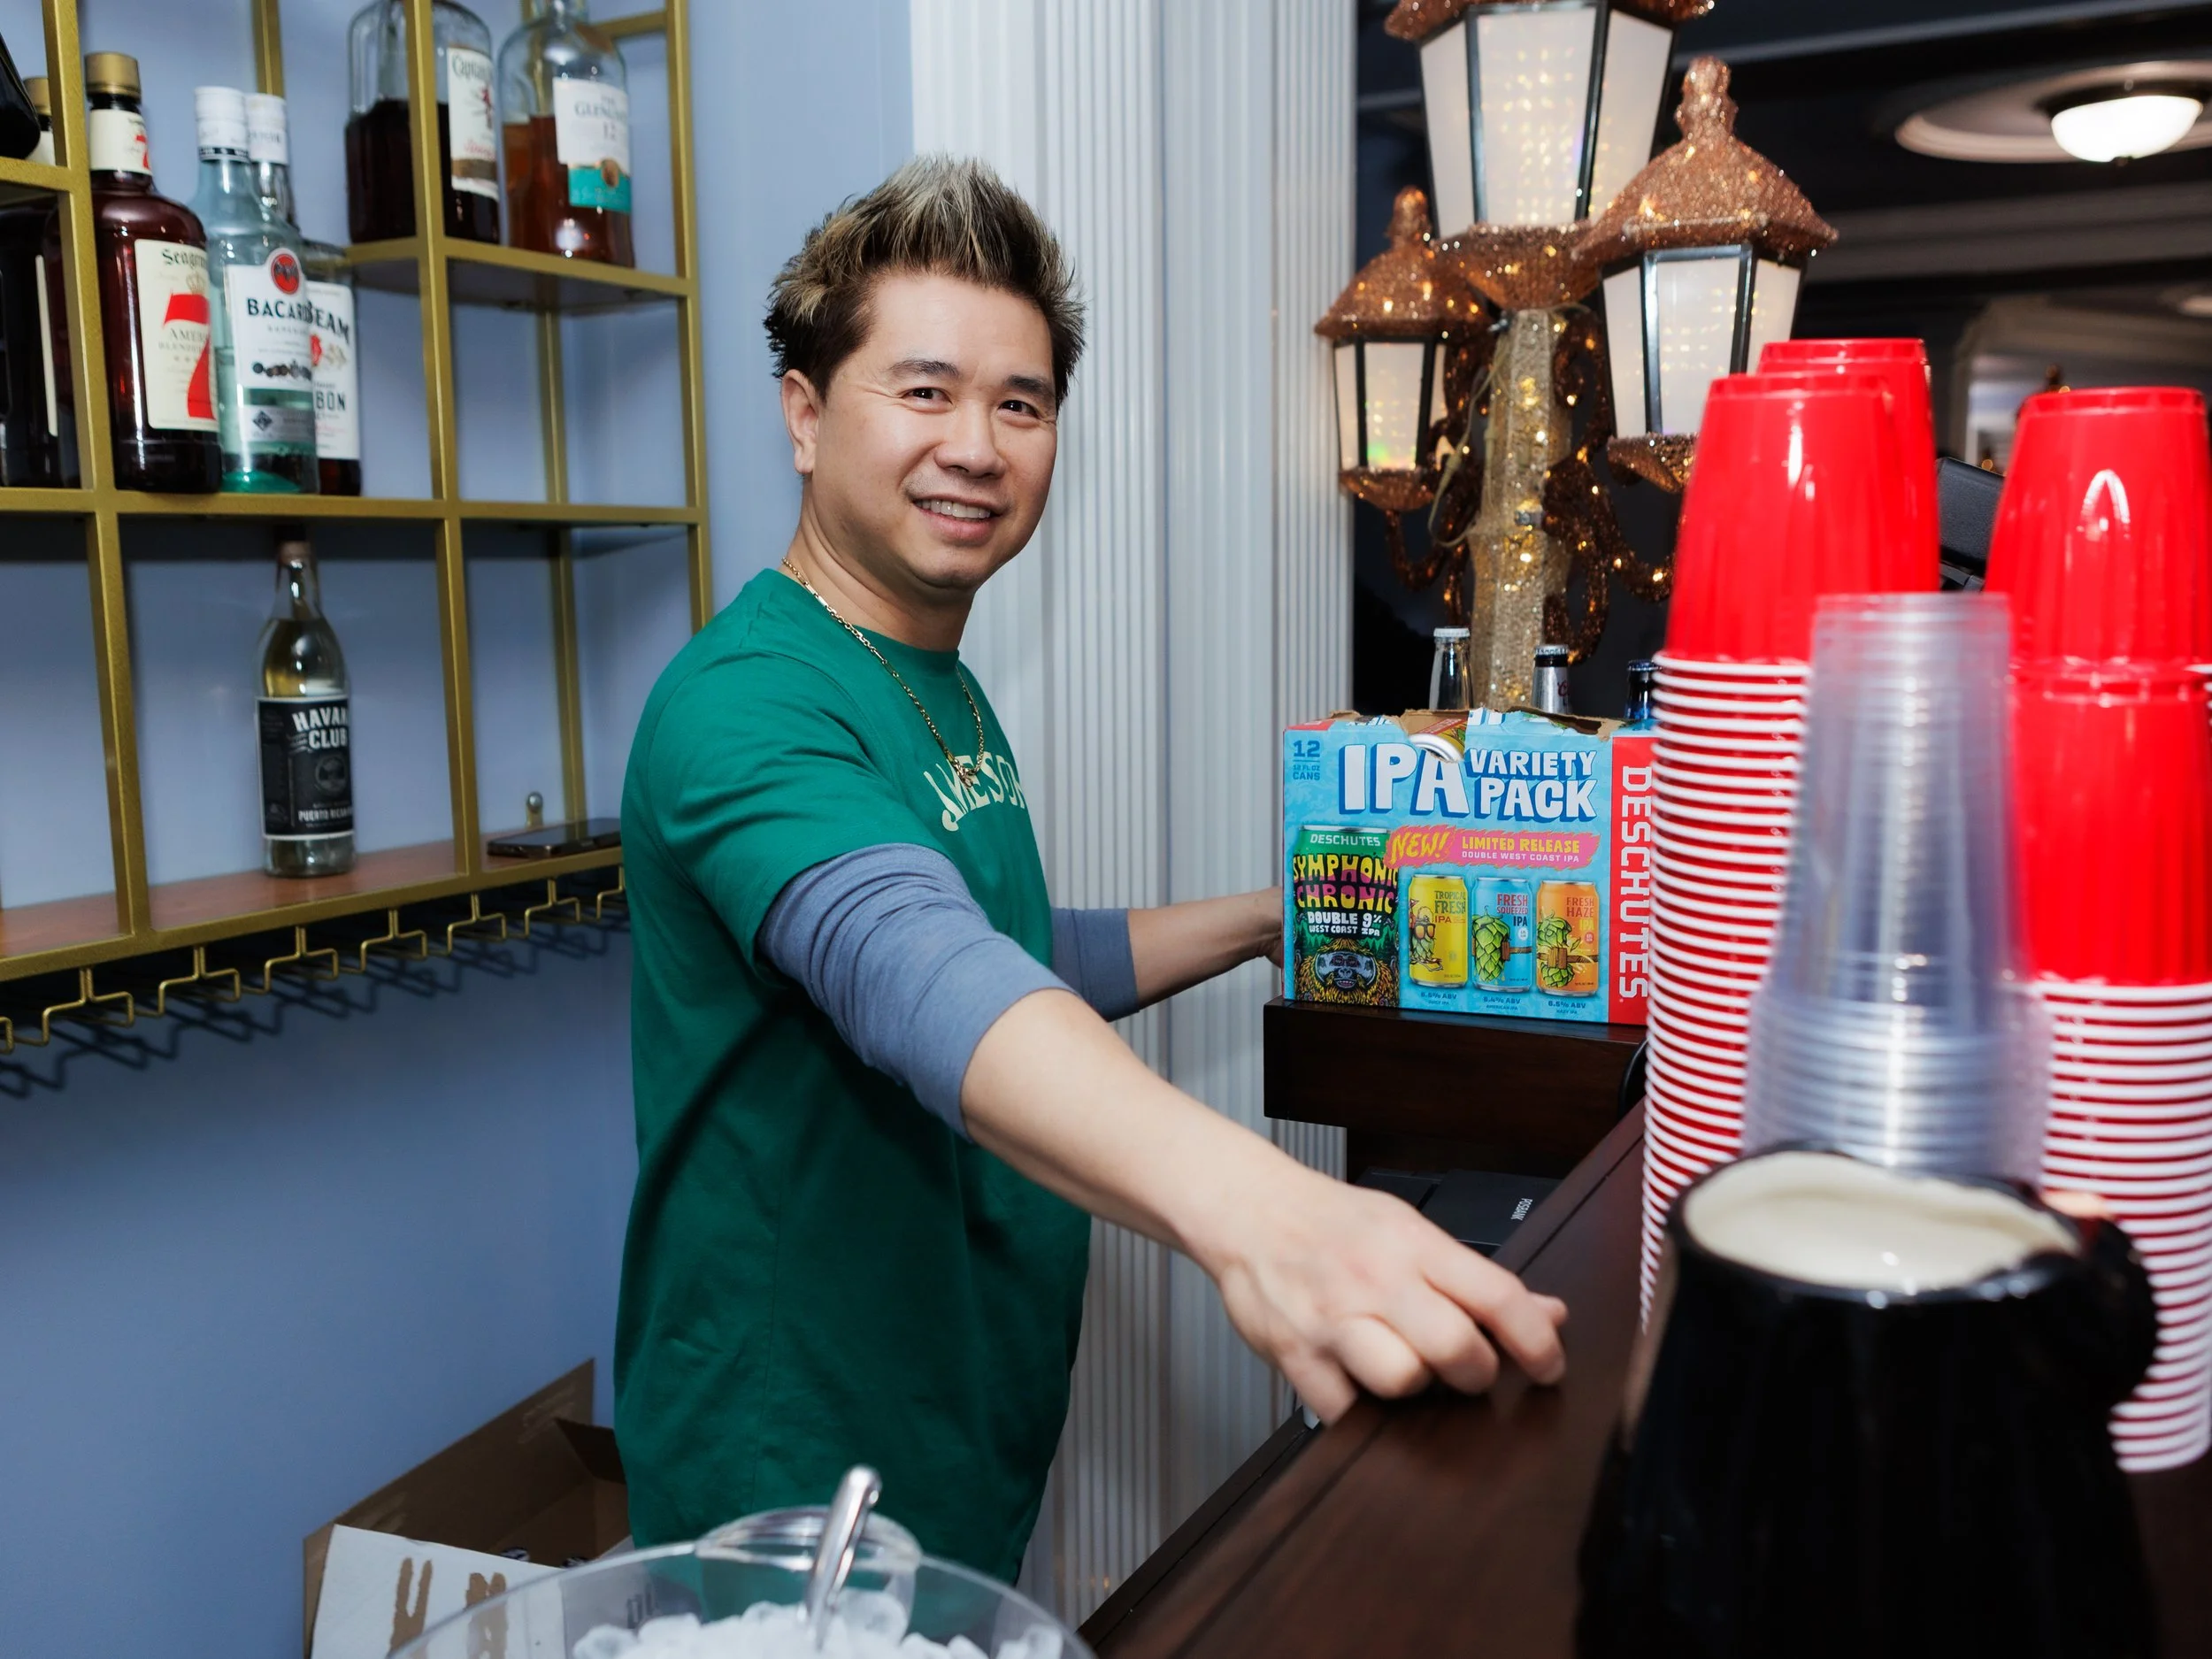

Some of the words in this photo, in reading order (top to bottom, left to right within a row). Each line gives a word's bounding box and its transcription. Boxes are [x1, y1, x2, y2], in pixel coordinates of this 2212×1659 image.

[308, 727, 348, 749] CLUB
[1293, 740, 1320, 758] 12
[1465, 749, 1596, 781] VARIETY
[1293, 772, 1320, 780] CANS
[1339, 743, 1470, 818] IPA
[1475, 778, 1598, 823] PACK
[1310, 833, 1381, 847] DESCHUTES
[1462, 836, 1516, 851] LIMITED
[1519, 838, 1580, 854] RELEASE
[1390, 832, 1451, 865] NEW!
[1500, 852, 1527, 861] WEST
[1622, 765, 1652, 998] DESCHUTES
[1296, 883, 1394, 914] CHRONIC
[1434, 890, 1466, 900] TROPICAL
[1497, 894, 1528, 906] FRESH
[1566, 896, 1594, 907] FRESH
[1434, 901, 1466, 914] FRESH
[1496, 906, 1528, 915] SQUEEZED
[1566, 907, 1594, 918] HAZE
[1307, 911, 1358, 925] DOUBLE
[1363, 912, 1382, 928] 9%
[1513, 916, 1528, 926] IPA
[1579, 918, 1594, 930] IPA
[1310, 925, 1329, 933] WEST
[1331, 926, 1358, 934] COAST
[1361, 927, 1380, 937] IPA
